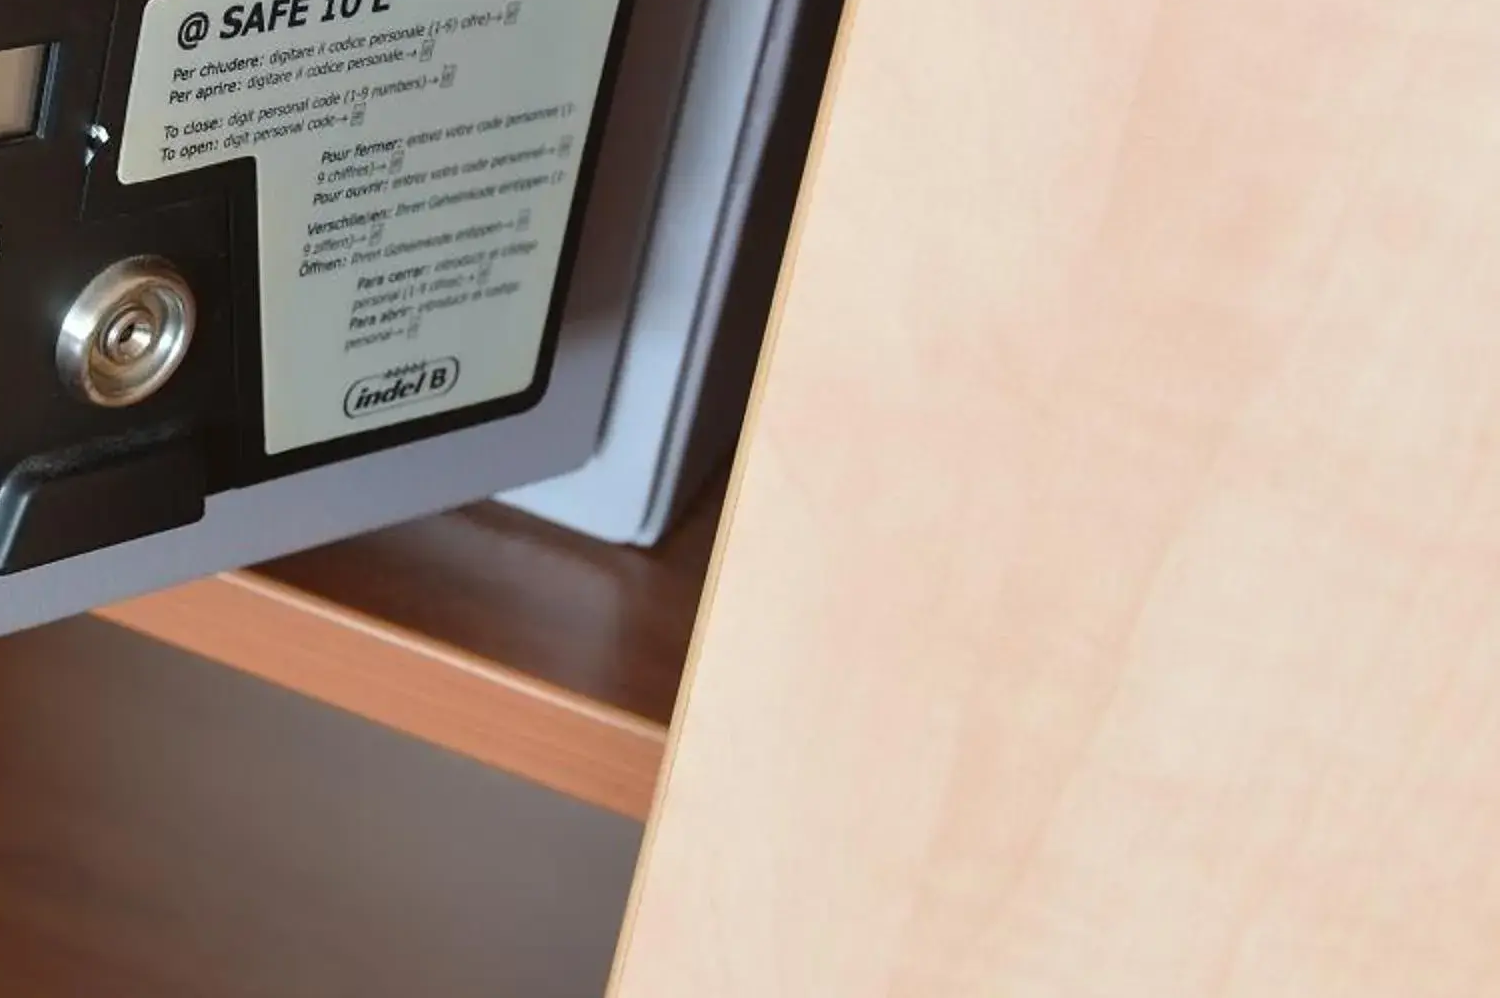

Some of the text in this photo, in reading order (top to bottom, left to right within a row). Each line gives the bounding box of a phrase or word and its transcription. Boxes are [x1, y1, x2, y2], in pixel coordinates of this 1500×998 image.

[177, 11, 209, 50] @
[172, 66, 196, 82] Per
[199, 54, 264, 77] chiudere:
[169, 89, 193, 104] Per
[195, 81, 241, 101] aprire:
[247, 71, 292, 90] digitare
[164, 124, 179, 140] To
[183, 117, 223, 136] close:
[227, 110, 254, 128] digit
[258, 97, 309, 123] personal
[311, 91, 341, 110] code
[161, 146, 176, 162] To
[179, 139, 219, 161] open:
[223, 130, 249, 150] digit
[253, 118, 304, 146] personal
[429, 367, 447, 390] B
